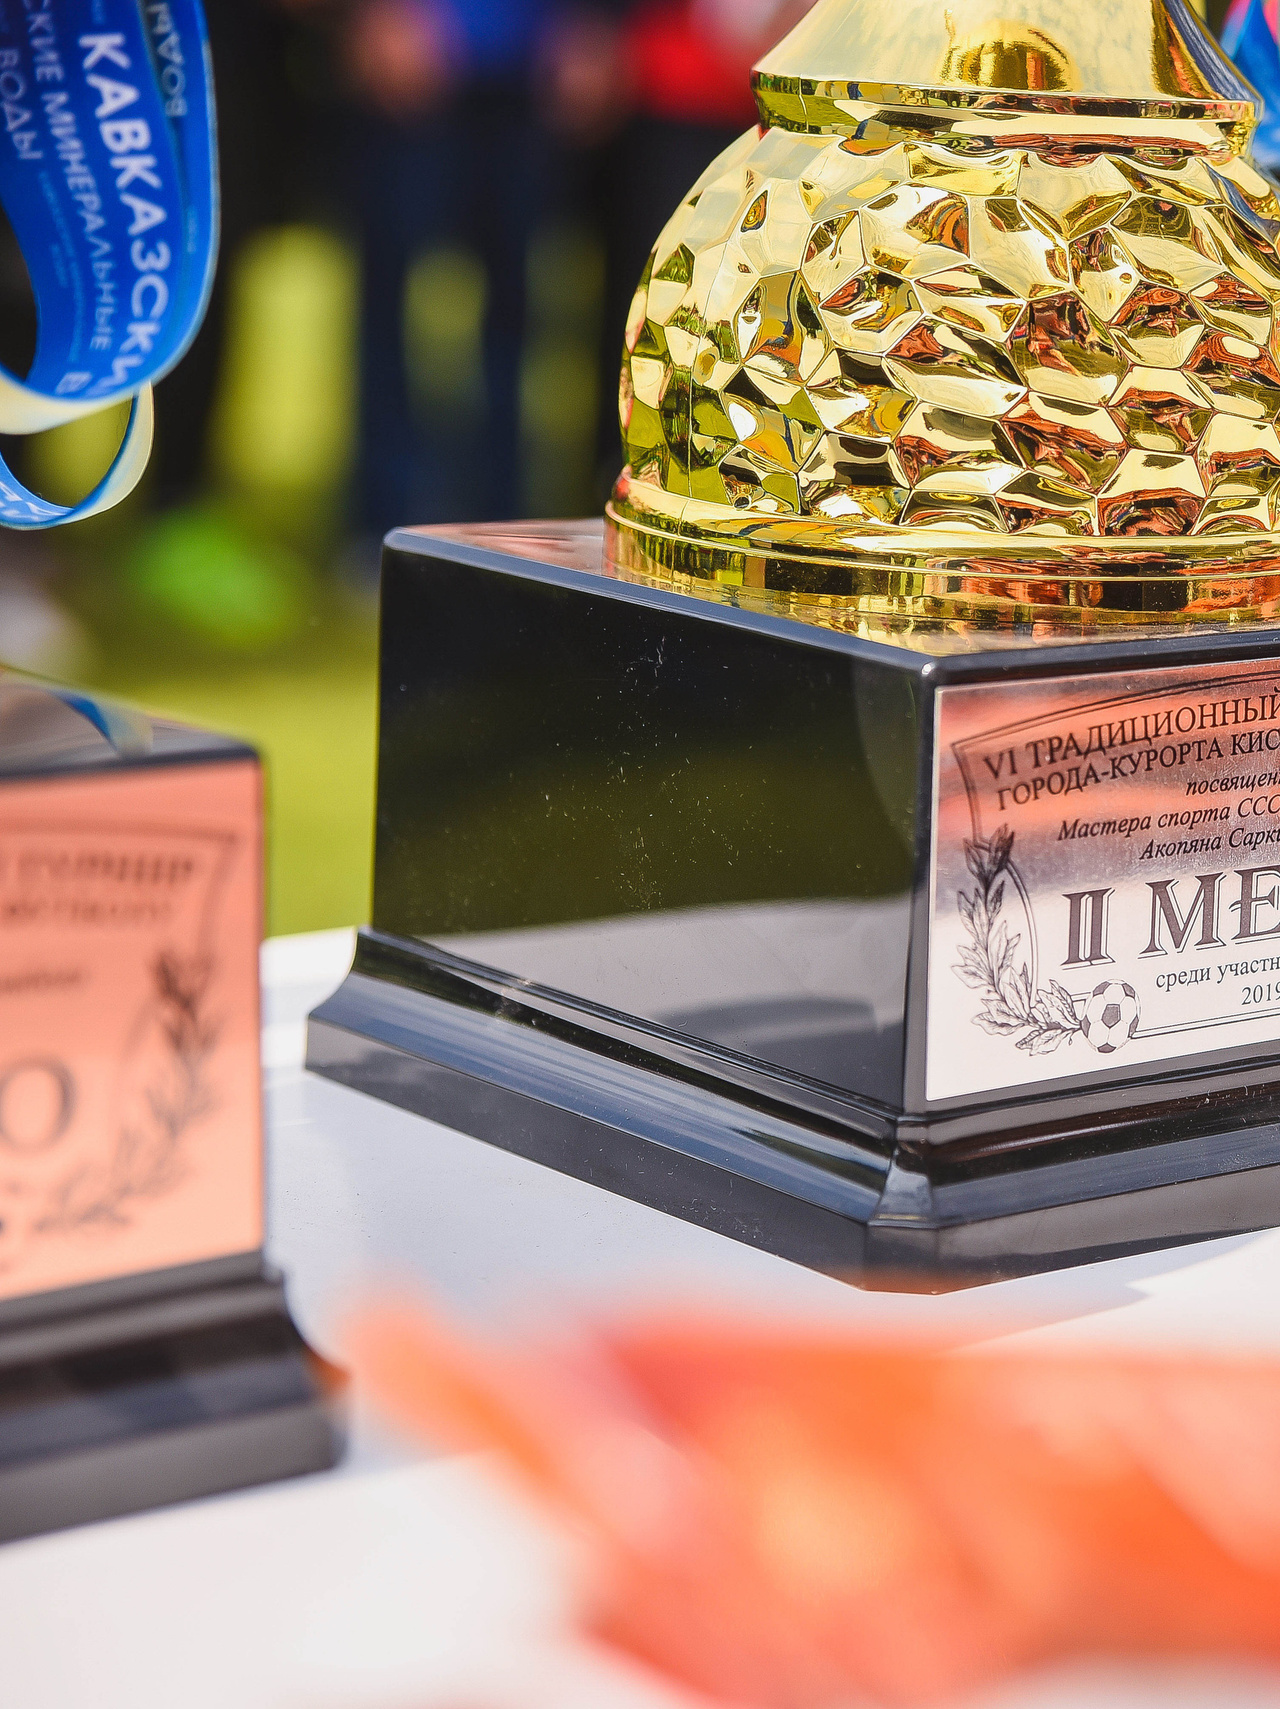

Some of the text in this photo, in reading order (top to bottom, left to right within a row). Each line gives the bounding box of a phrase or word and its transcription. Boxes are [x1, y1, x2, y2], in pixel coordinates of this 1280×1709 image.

[41, 91, 117, 350] МИНЕРАЛЬНЫЕ
[983, 749, 1017, 780] VI
[997, 737, 1224, 811] ГОРОДА-КУРОРТА
[1057, 819, 1152, 842] Мастера
[1157, 807, 1230, 831] спорта
[1138, 834, 1222, 861] Акопяна
[1154, 963, 1212, 990] среди
